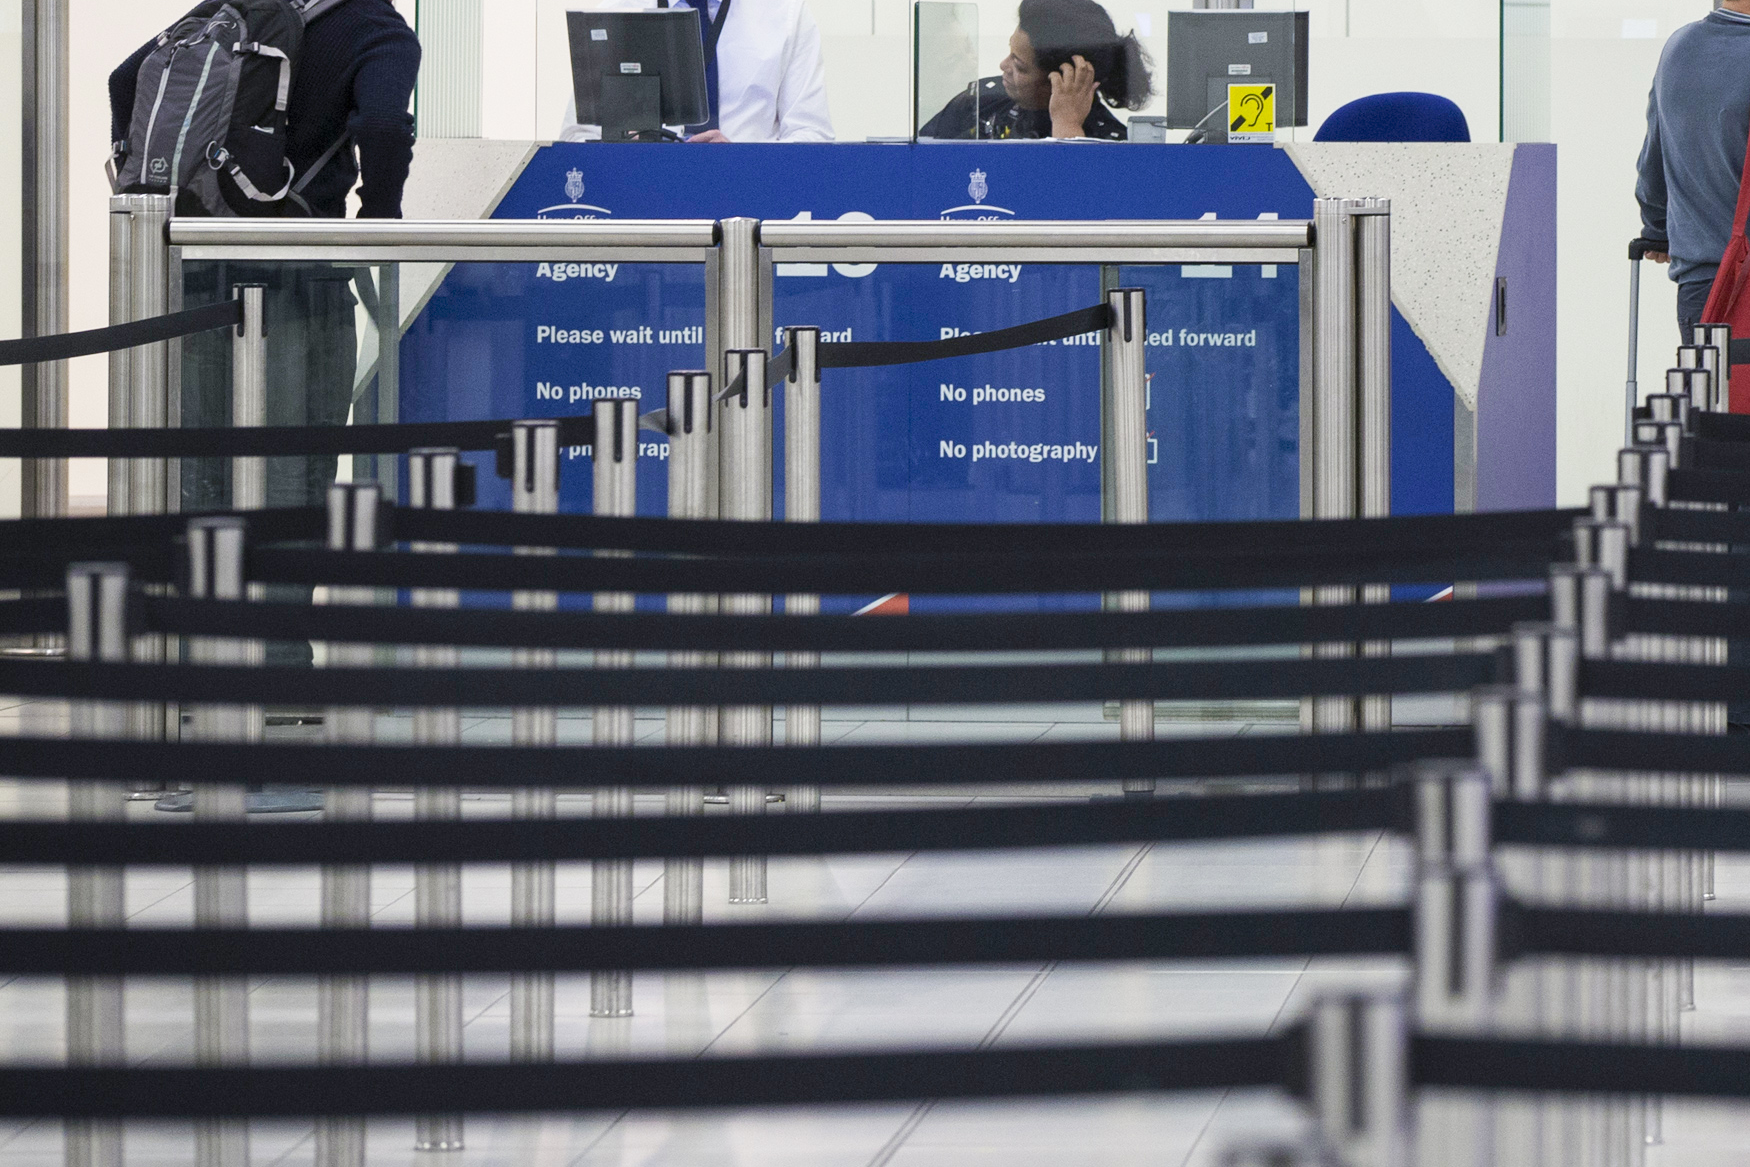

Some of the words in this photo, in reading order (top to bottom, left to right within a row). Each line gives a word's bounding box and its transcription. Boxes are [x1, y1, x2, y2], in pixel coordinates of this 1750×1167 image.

[536, 263, 618, 282] Agency
[939, 264, 1022, 283] Agency
[536, 326, 604, 344] Please
[610, 326, 653, 344] wait
[658, 326, 703, 344] until
[1178, 329, 1256, 347] forward
[536, 382, 564, 400] No
[569, 382, 642, 403] phones
[939, 384, 967, 403] No
[972, 384, 1046, 406] phones
[939, 440, 967, 459] No
[972, 440, 1098, 464] photography
